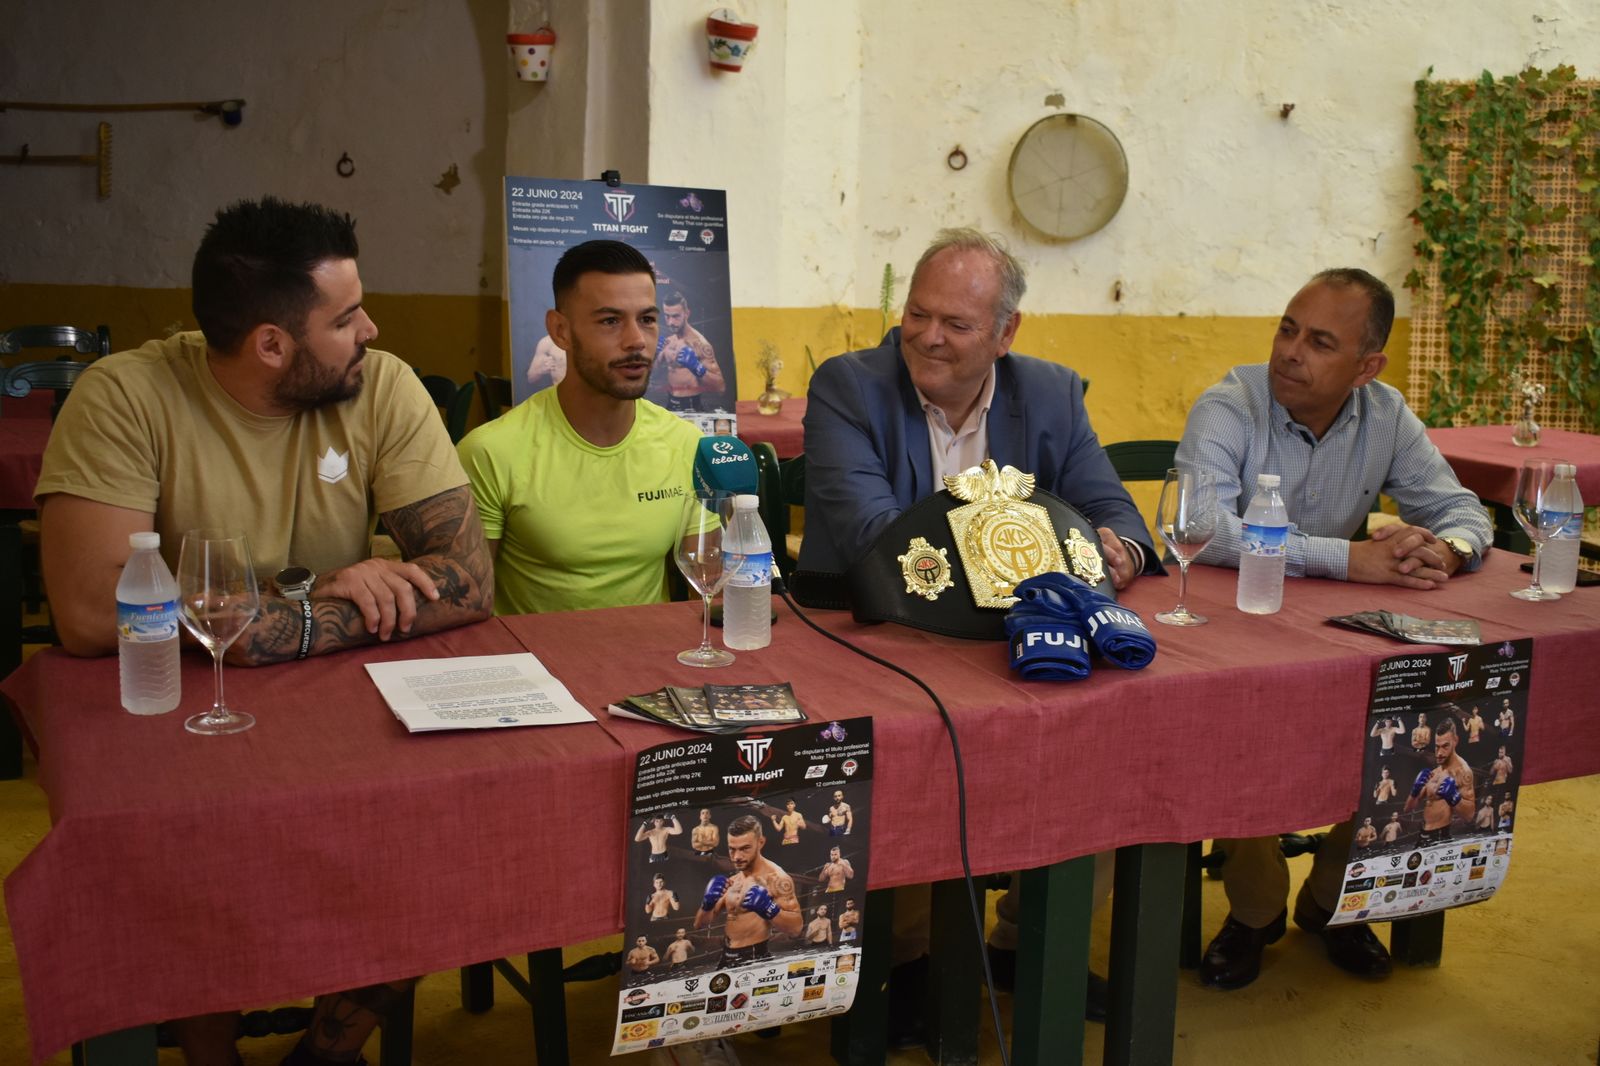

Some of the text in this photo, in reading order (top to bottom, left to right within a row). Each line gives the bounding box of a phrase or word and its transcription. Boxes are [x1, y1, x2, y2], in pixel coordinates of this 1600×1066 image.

[512, 188, 583, 200] 22 JUNIO 2024
[592, 223, 648, 234] TITAN FIGHT
[638, 486, 684, 502] FUJIMAE
[1380, 659, 1432, 673] 22 JUNIO 2024
[1436, 680, 1474, 693] TITAN FIGHT
[640, 743, 712, 766] 22 JUNIO 2024
[722, 769, 784, 784] TITAN FIGHT
[758, 974, 784, 983] SELECT
